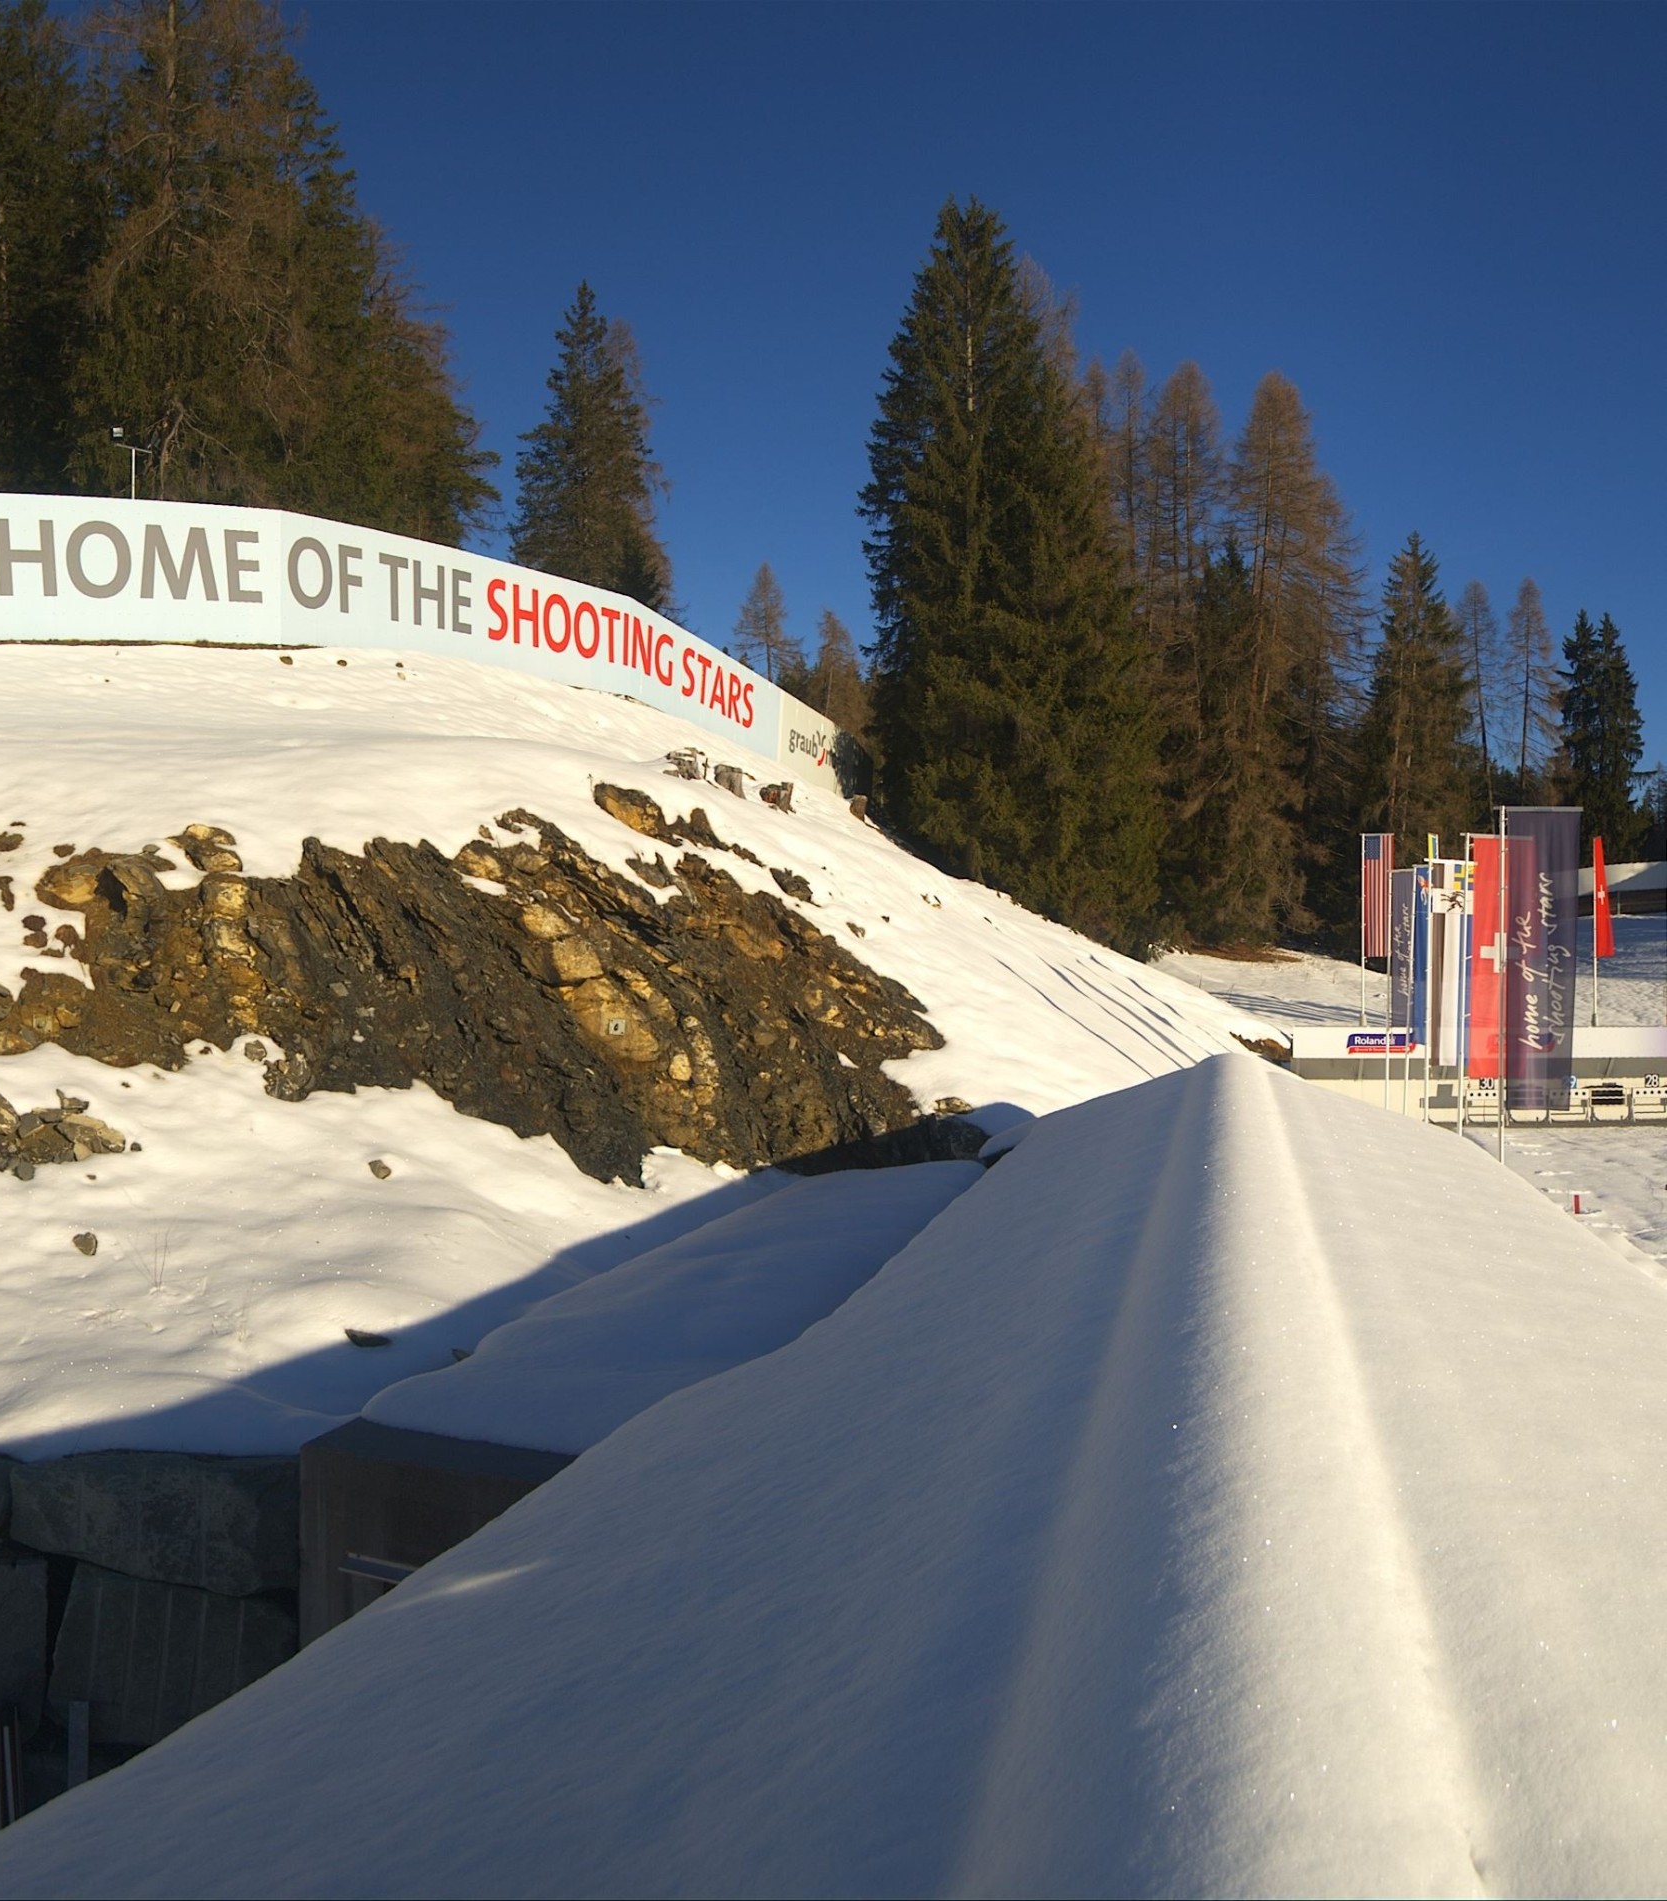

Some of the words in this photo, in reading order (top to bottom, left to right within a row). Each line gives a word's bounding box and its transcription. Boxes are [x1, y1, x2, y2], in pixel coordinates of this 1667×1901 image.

[287, 535, 364, 614] OF
[378, 552, 473, 635] THE
[486, 577, 674, 687] SHOOTING
[680, 646, 756, 729] STARS
[1354, 1035, 1387, 1046] Roland
[1479, 1077, 1495, 1090] 30
[1645, 1073, 1660, 1088] 28
